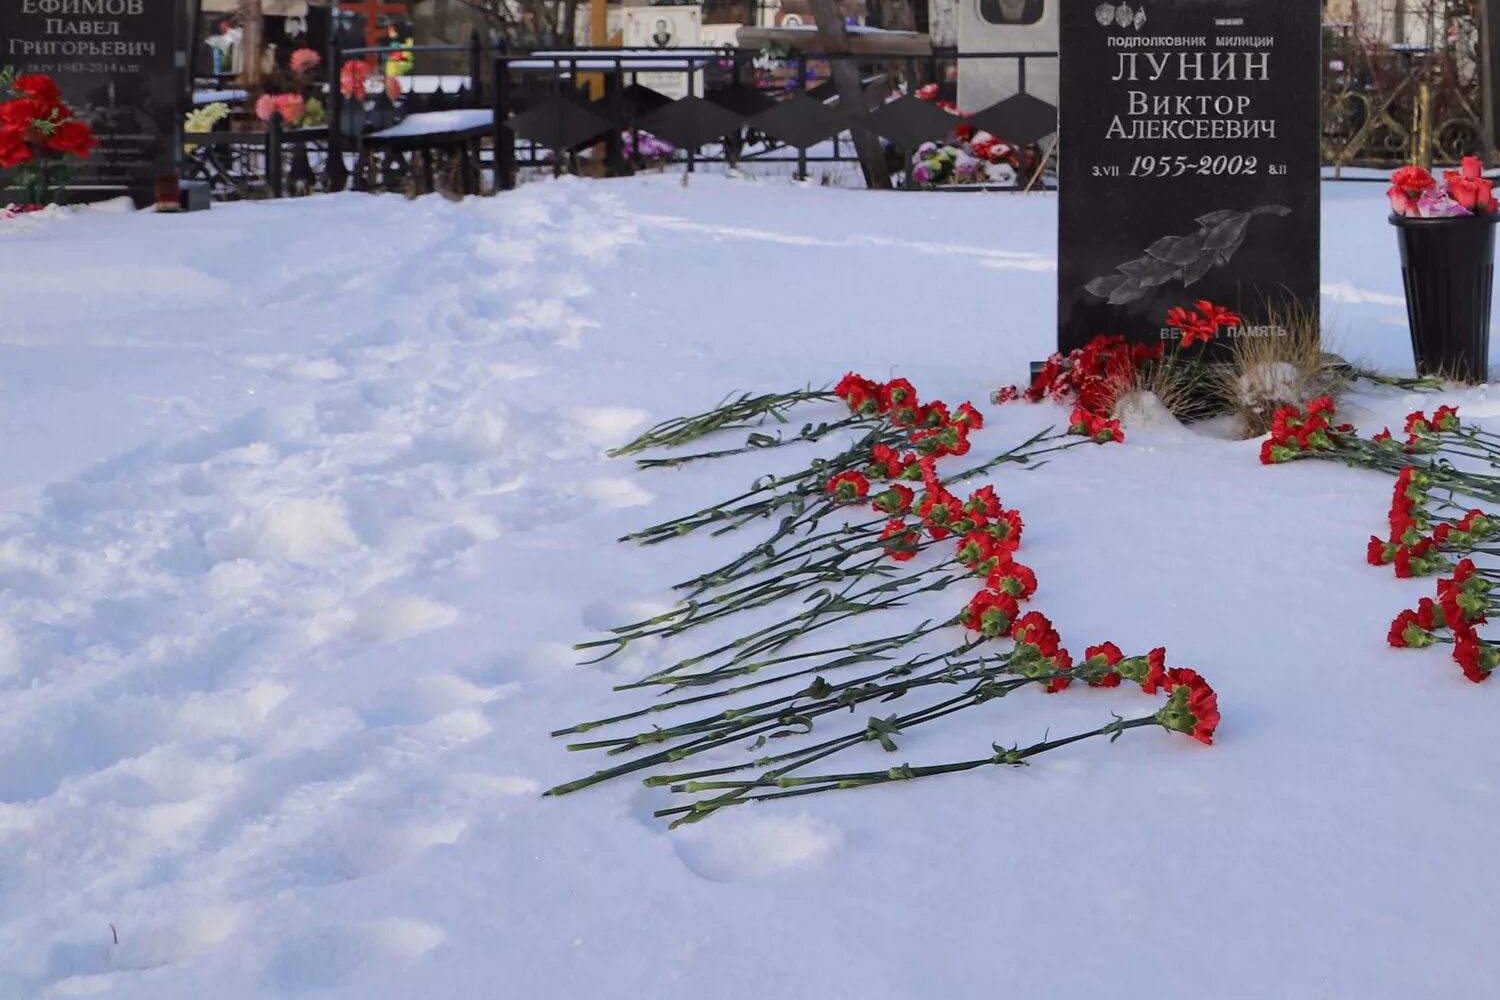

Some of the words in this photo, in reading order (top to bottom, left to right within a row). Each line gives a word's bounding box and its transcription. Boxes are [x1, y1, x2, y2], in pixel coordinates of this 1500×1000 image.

[46, 18, 119, 34] ПАВЕЛ
[9, 39, 156, 55] ГРИГОРЬЕВИЧ
[1112, 52, 1271, 81] ЛУНИН
[1128, 91, 1250, 115] ВИКТОР
[1105, 115, 1276, 139] АЛЕКСЕЕВИЧ
[1128, 155, 1258, 177] 1955-2002
[1227, 325, 1287, 339] ПАМЯТЬ
